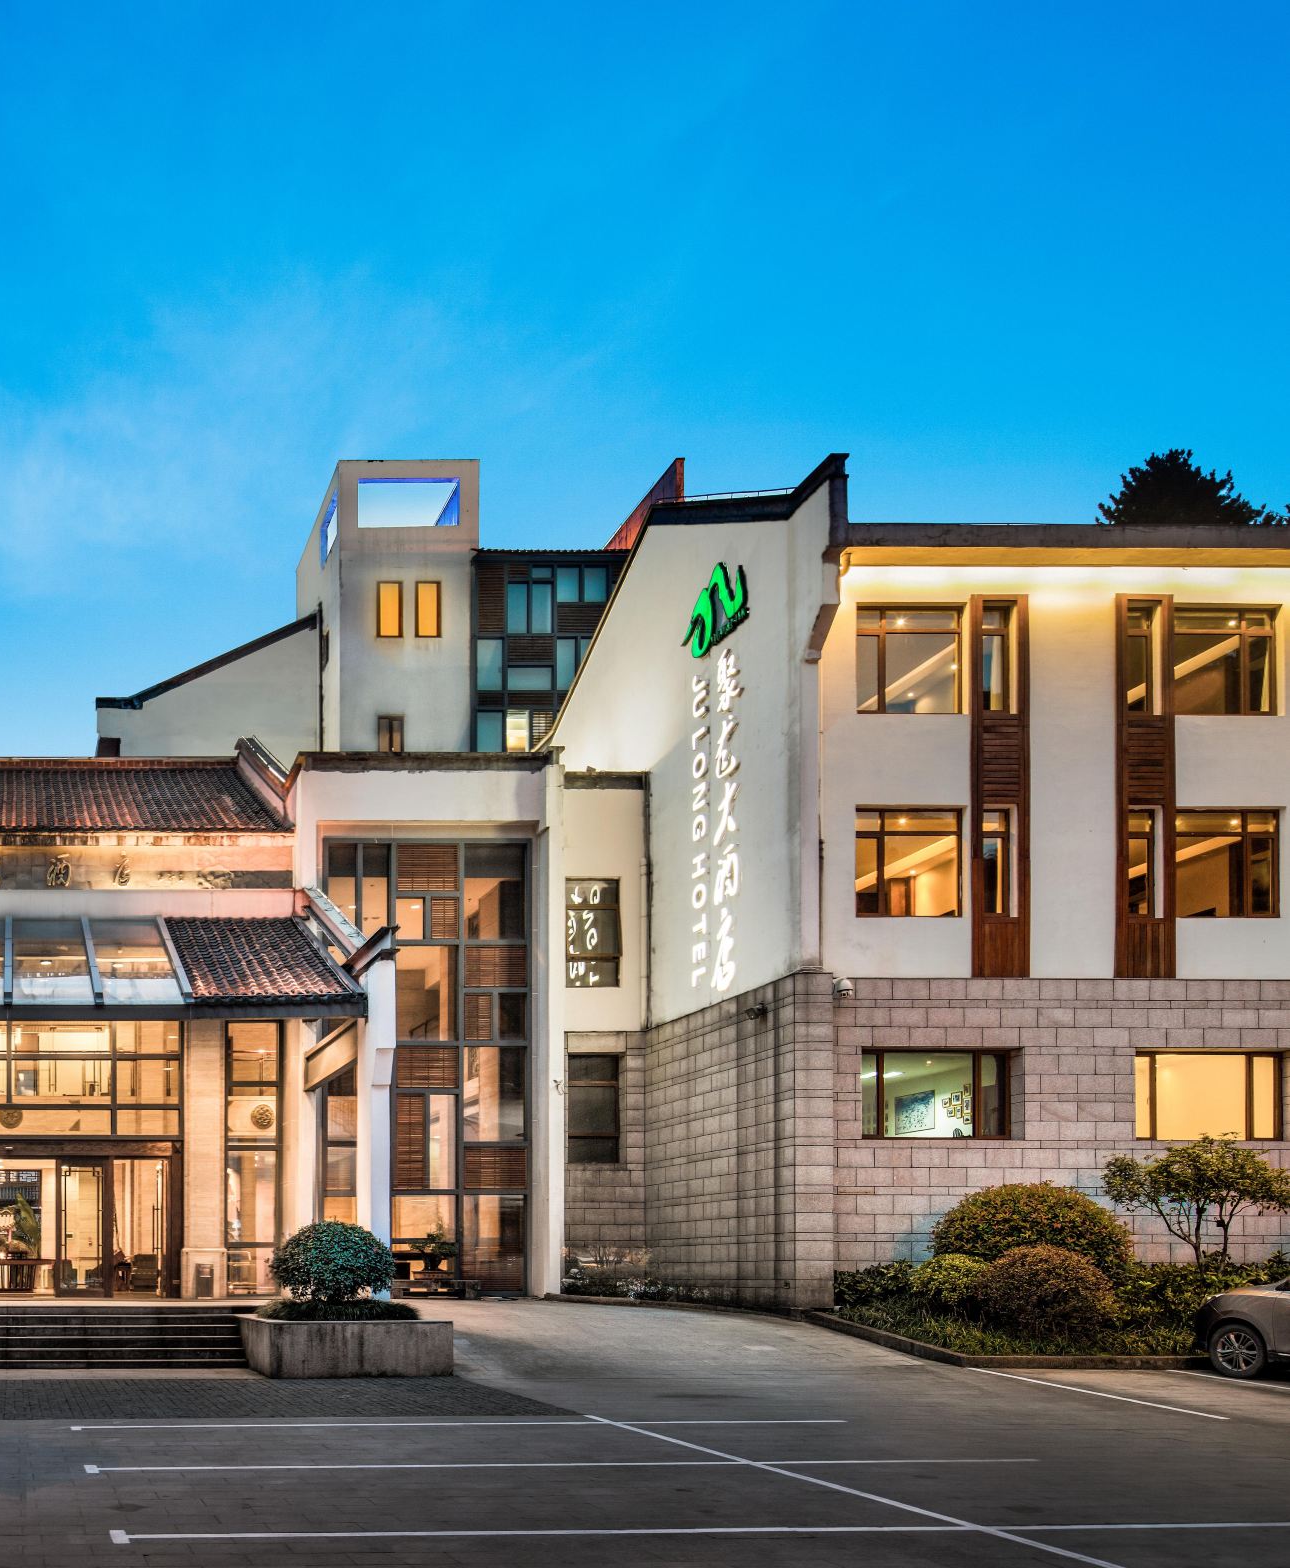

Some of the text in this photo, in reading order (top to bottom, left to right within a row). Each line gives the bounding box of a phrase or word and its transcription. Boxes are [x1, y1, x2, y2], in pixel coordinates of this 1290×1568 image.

[691, 675, 710, 988] JU LONG HOTEL
